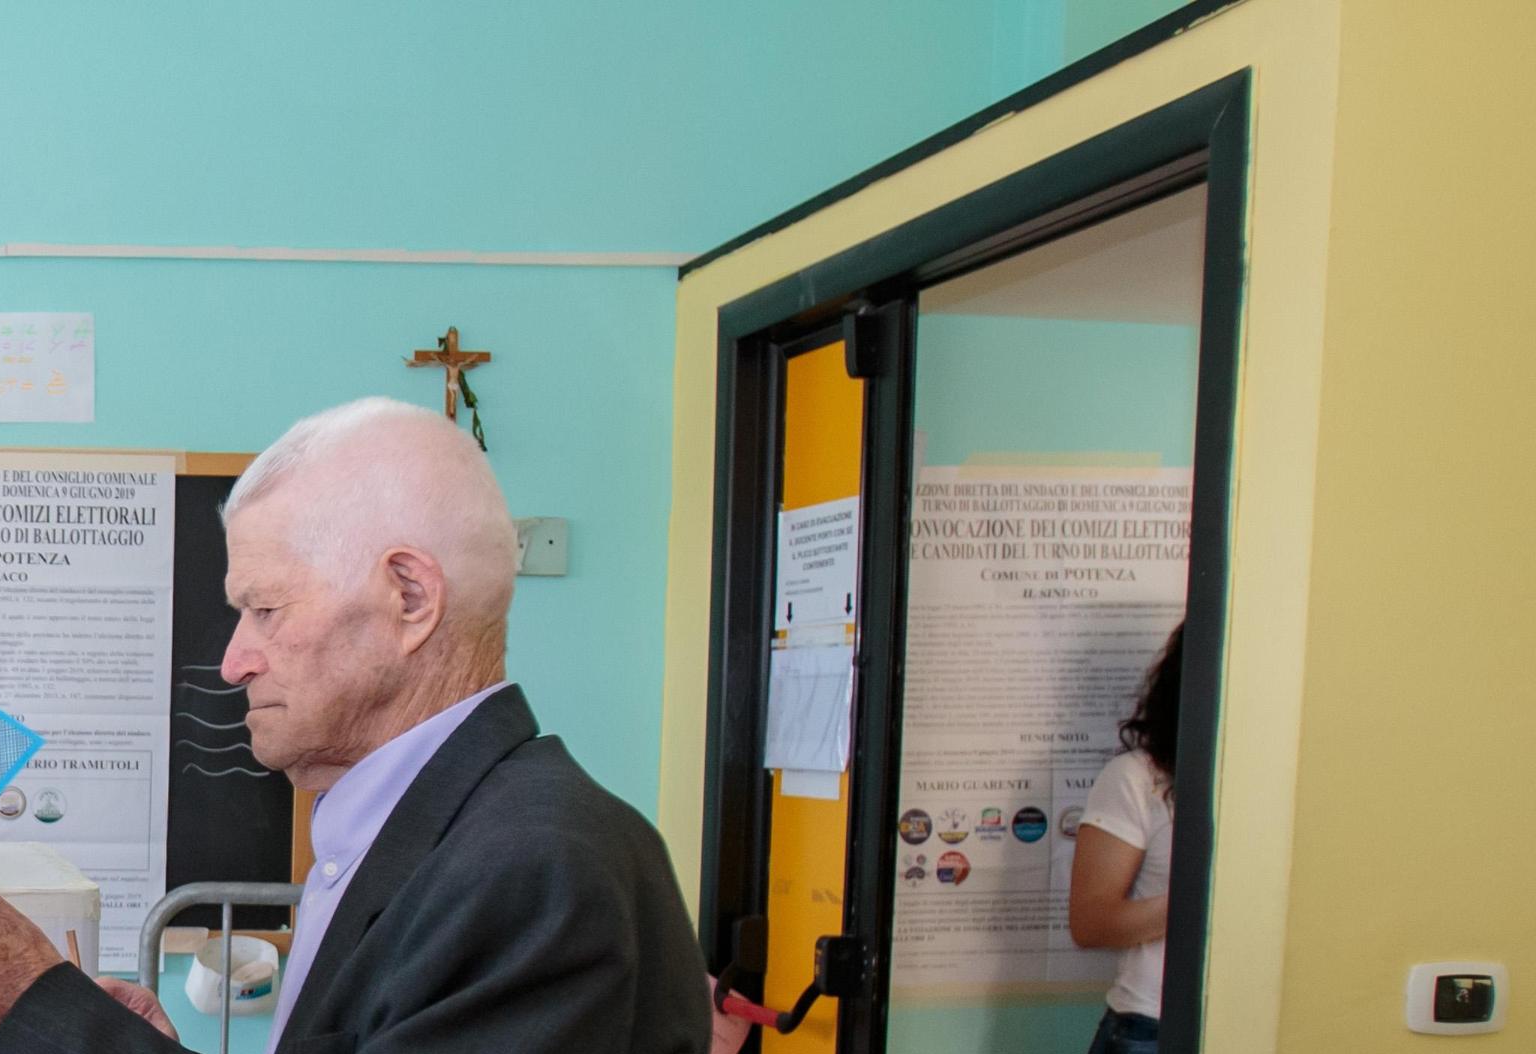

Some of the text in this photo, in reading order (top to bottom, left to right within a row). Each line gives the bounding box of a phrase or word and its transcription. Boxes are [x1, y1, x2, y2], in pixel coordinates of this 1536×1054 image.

[3, 471, 10, 482] E
[12, 471, 33, 483] DEL
[35, 471, 94, 484] CONSIGLIO
[96, 472, 157, 486] COMUNALE
[2, 485, 60, 499] DOMENICA
[62, 486, 67, 499] 9
[70, 486, 112, 499] GIUGNO
[114, 486, 135, 500] 2019
[954, 483, 1000, 497] DIRETTA
[1001, 483, 1020, 497] DEL
[1023, 483, 1069, 498] SINDACO
[1080, 484, 1099, 498] DEL
[1103, 485, 1160, 498] CONSIGLIO
[922, 499, 956, 512] TURNO
[958, 499, 970, 512] DI
[972, 499, 1055, 513] BALLOTTAGGIO
[1057, 500, 1068, 513] DI
[1070, 500, 1127, 513] DOMENICA
[56, 506, 156, 527] ELETTORALI
[911, 518, 1025, 538] ONVOCAZIONE
[1031, 519, 1056, 538] DEI
[1061, 520, 1117, 539] COMIZI
[15, 528, 29, 544] DI
[33, 528, 144, 547] BALLOTTAGGIO
[911, 543, 919, 560] E
[922, 543, 997, 560] CANDIDATI
[1002, 543, 1026, 560] DEL
[1034, 543, 1080, 560] TURNO
[1084, 544, 1096, 560] DI
[1064, 568, 1136, 582] POTENZA
[1023, 588, 1099, 599] IL SINDACO
[24, 759, 140, 771] ERIO TRAMUTOLI
[916, 780, 960, 792] MARIO
[963, 779, 1032, 791] GUARENTE
